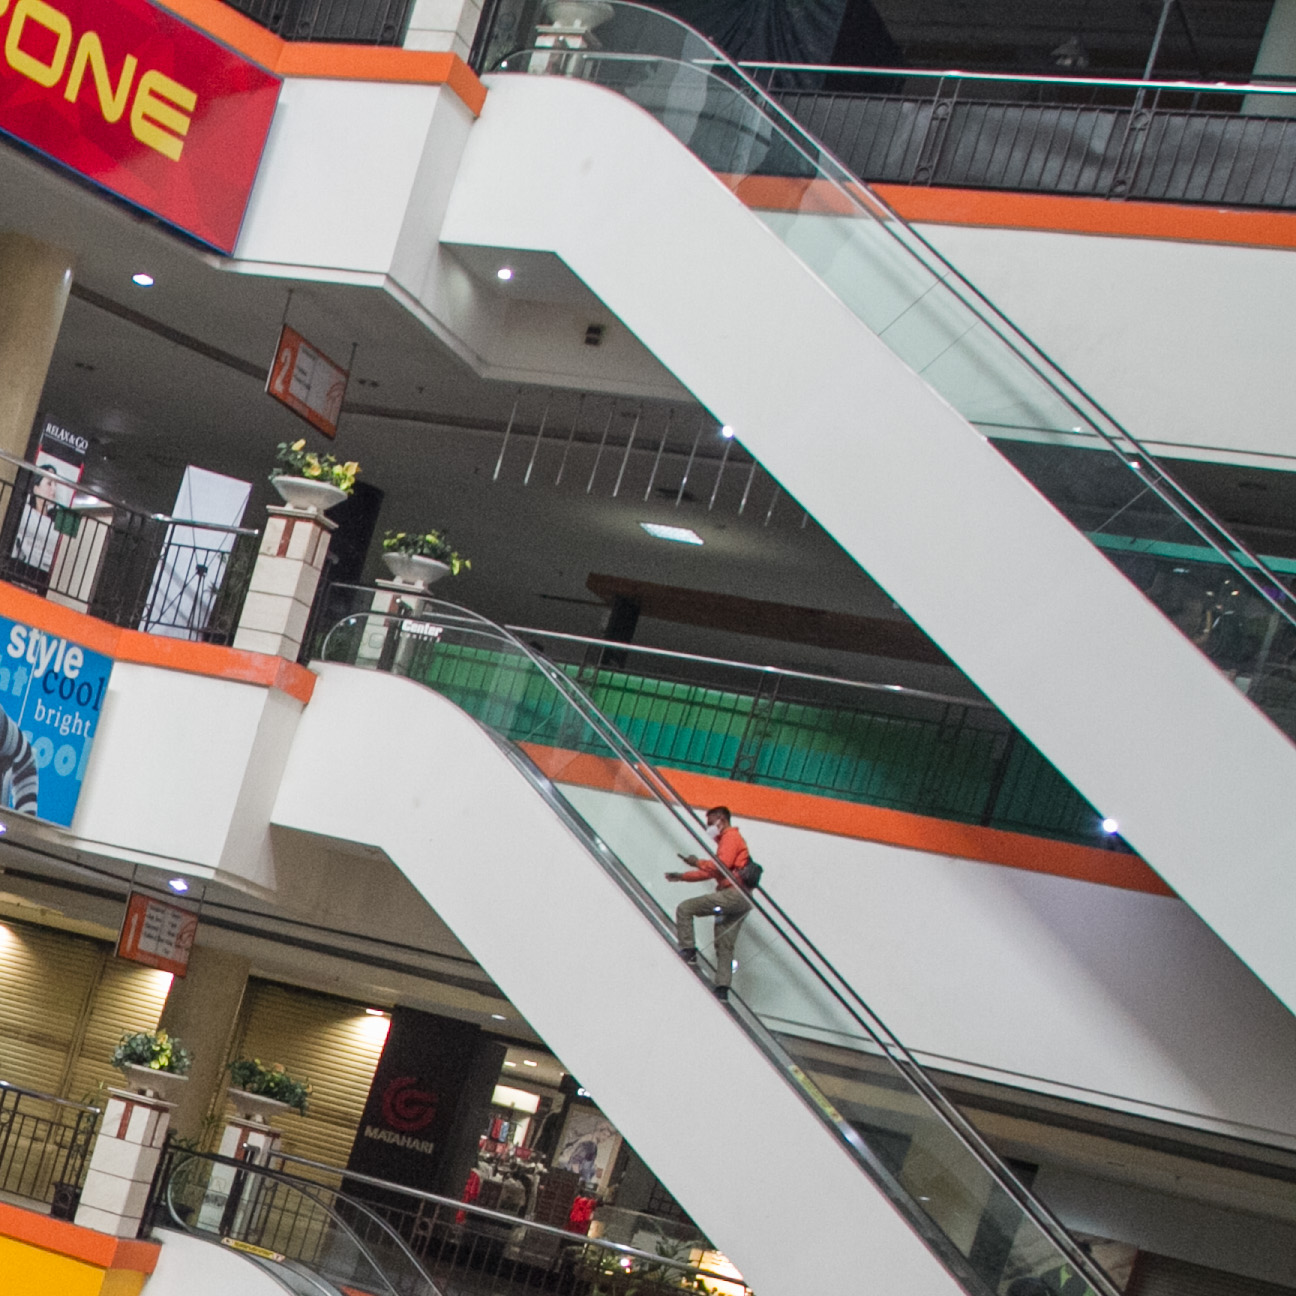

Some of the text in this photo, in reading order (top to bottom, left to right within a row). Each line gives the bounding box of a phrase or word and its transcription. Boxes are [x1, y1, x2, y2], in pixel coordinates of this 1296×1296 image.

[274, 347, 292, 394] 2
[7, 624, 84, 679] style
[42, 668, 106, 711] cool
[34, 698, 92, 738] bright
[22, 730, 94, 781] ool
[364, 1125, 435, 1155] MATAHARI
